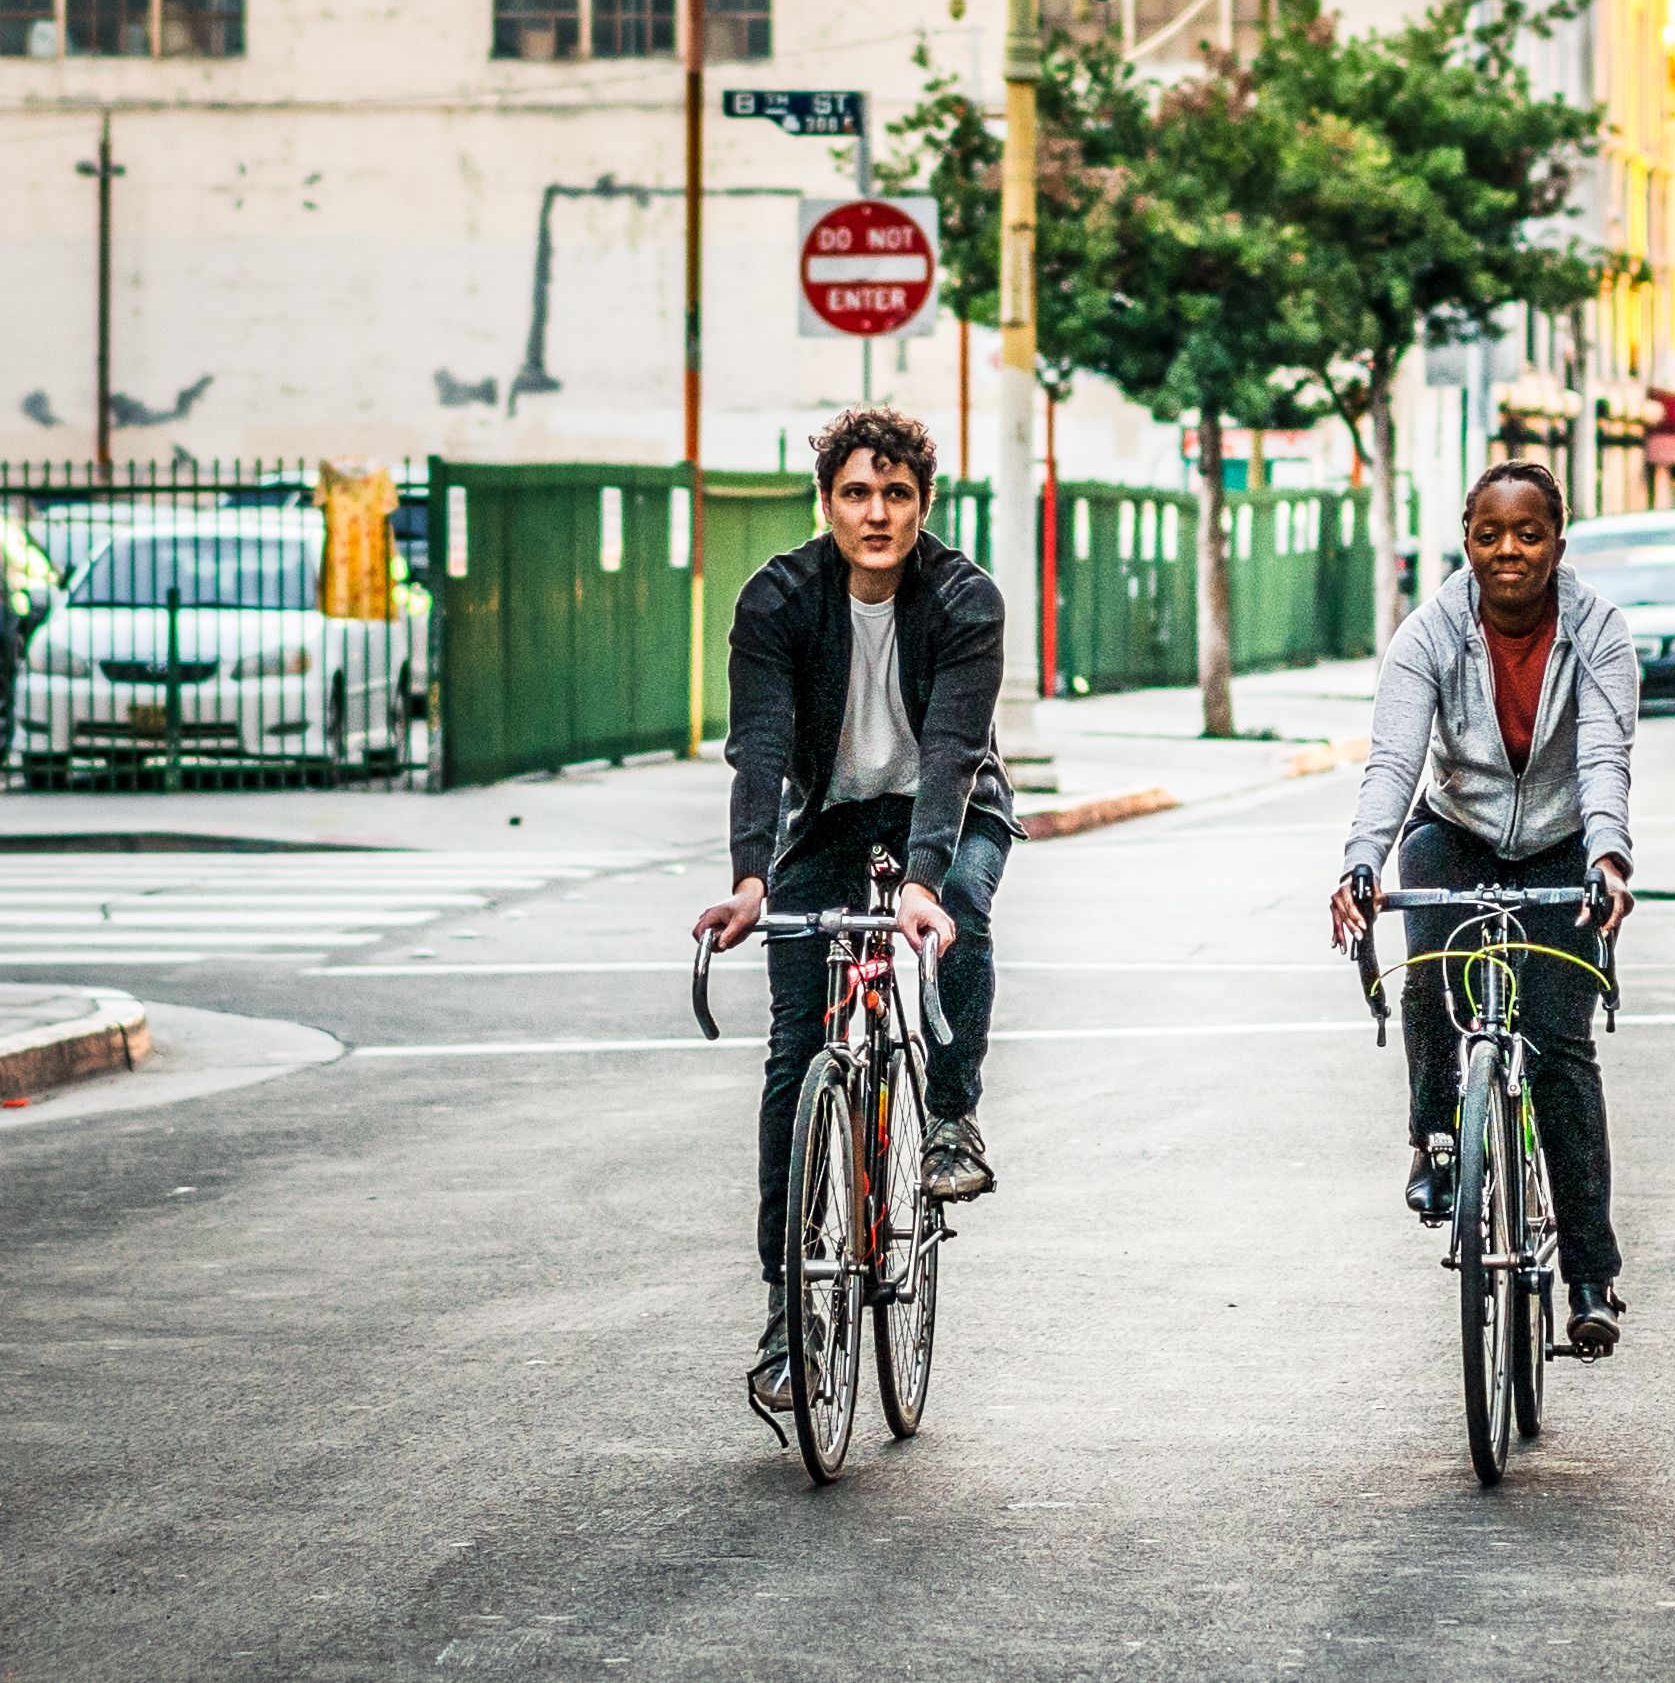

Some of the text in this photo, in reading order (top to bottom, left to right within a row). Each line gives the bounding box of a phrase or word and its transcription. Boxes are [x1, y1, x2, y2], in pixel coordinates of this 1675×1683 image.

[811, 92, 848, 115] ST
[817, 225, 914, 251] DO NOT
[826, 288, 907, 312] ENTER
